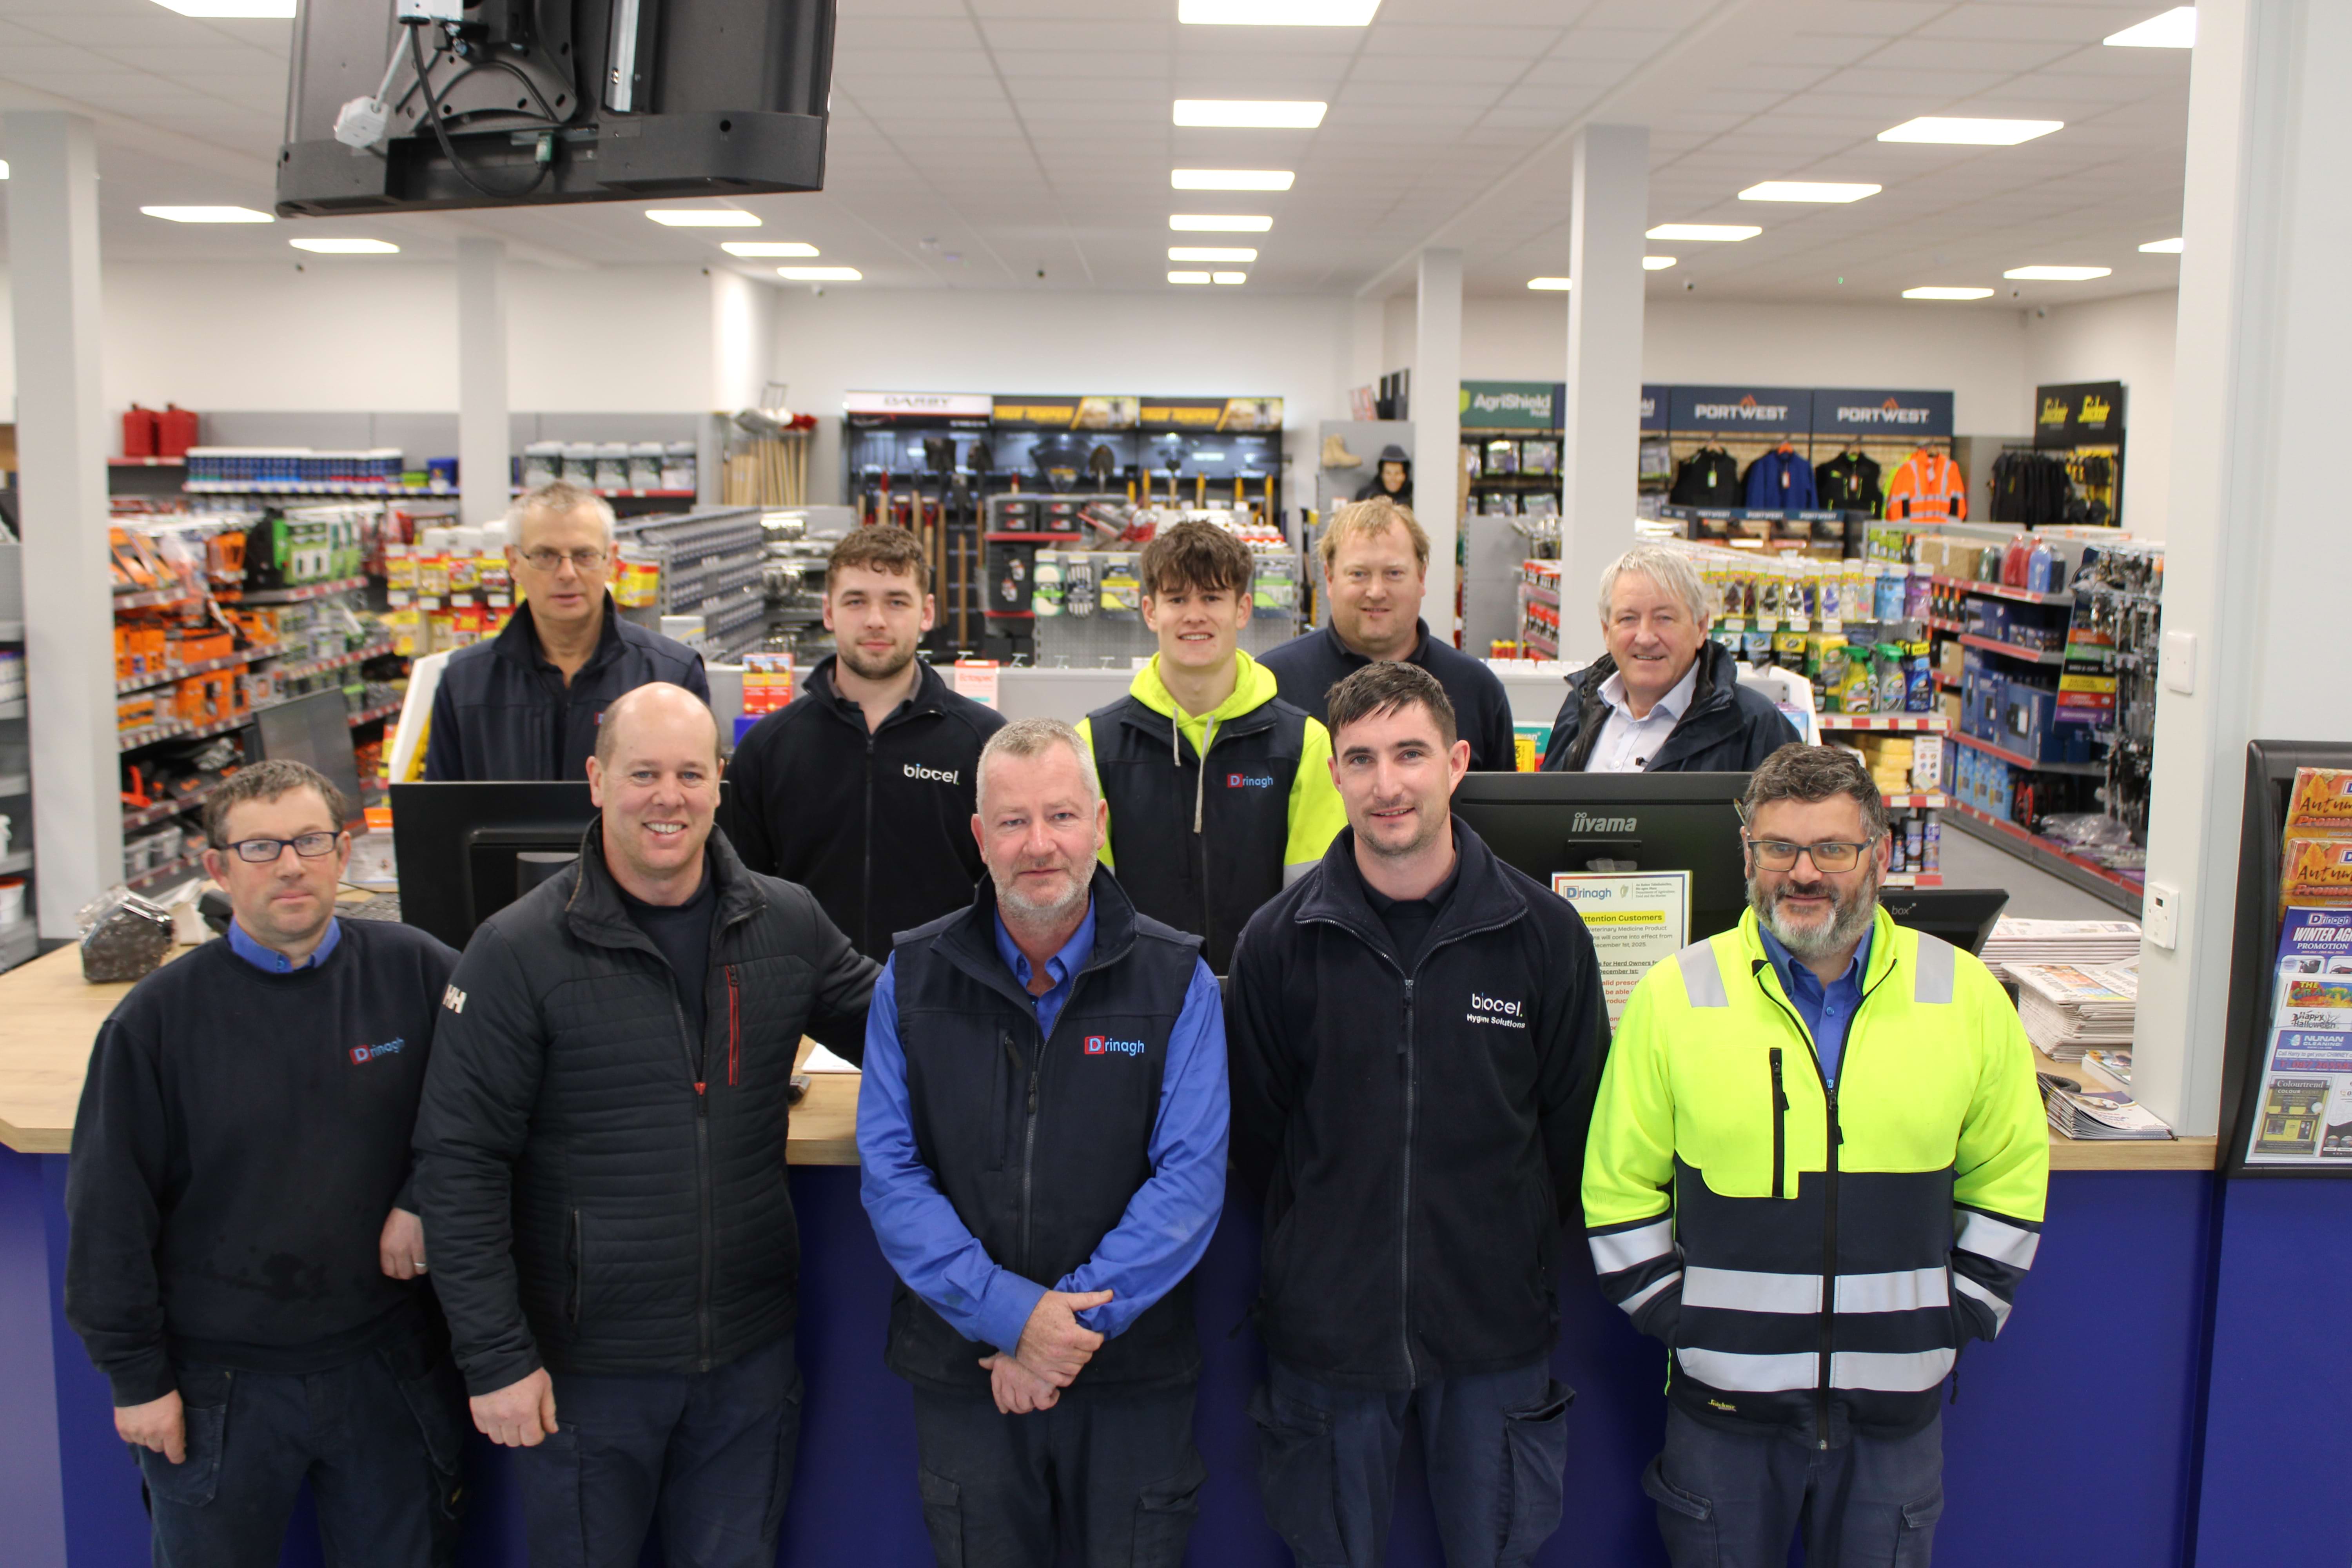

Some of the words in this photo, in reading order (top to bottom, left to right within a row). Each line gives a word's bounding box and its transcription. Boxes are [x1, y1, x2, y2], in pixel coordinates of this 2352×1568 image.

[1474, 392, 1551, 412] AgriShield
[1695, 404, 1788, 421] PORTWEST
[1837, 406, 1929, 424] PORTWEST
[1229, 775, 1274, 788] Drinagh
[1571, 812, 1637, 832] iiyama
[1566, 886, 1612, 900] Drinagh
[1891, 905, 1909, 915] box
[2311, 915, 2350, 925] Drinagh
[2293, 927, 2336, 941] WINTER
[1491, 1016, 1526, 1029] Solutions
[2299, 1011, 2324, 1022] Happy
[2294, 1020, 2336, 1029] Halloween
[1086, 1036, 1145, 1056] Drinagh
[2277, 1080, 2324, 1088] Colourtrend
